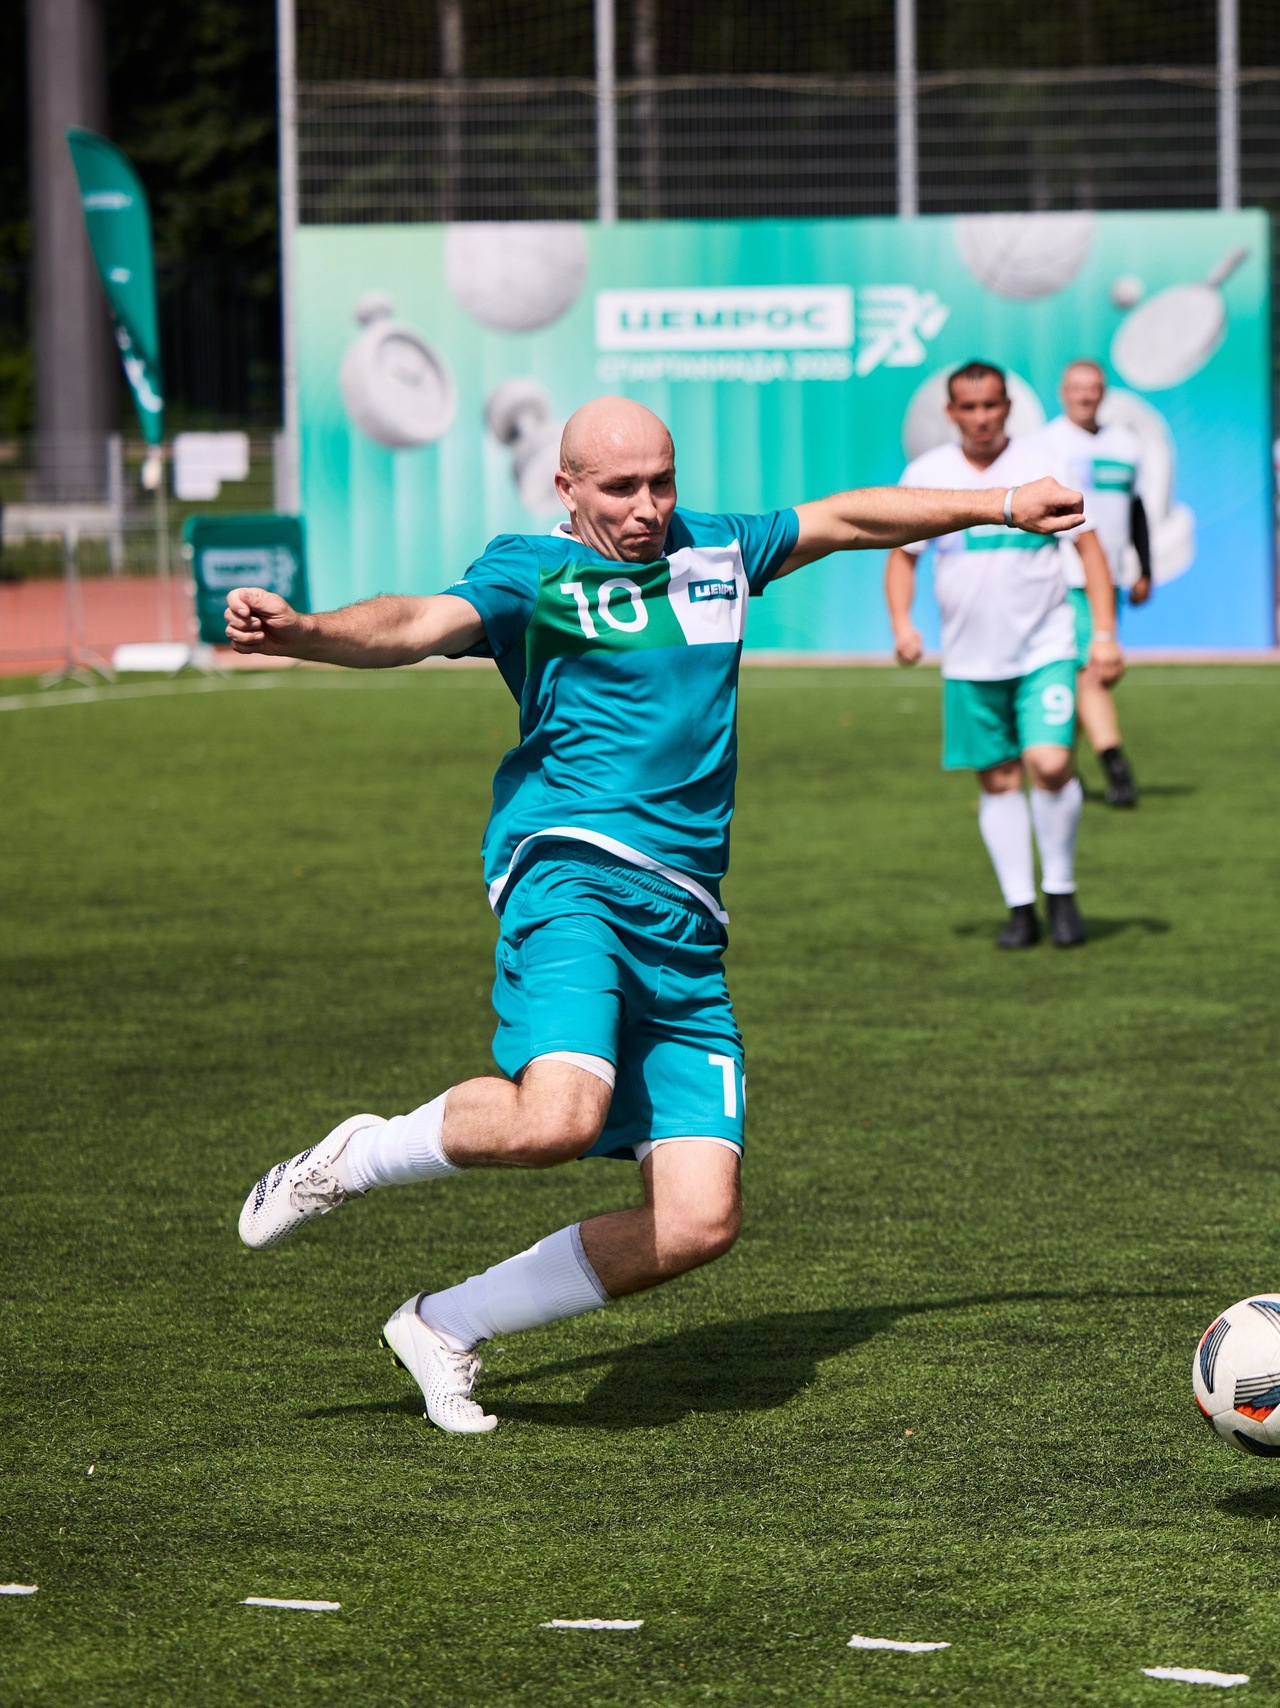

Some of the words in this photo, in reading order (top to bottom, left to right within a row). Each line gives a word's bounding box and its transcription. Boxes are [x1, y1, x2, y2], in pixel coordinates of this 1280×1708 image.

[617, 306, 832, 334] ЦЕМРОС
[560, 577, 649, 639] 10
[1041, 683, 1075, 726] 9
[708, 1053, 746, 1118] 1
